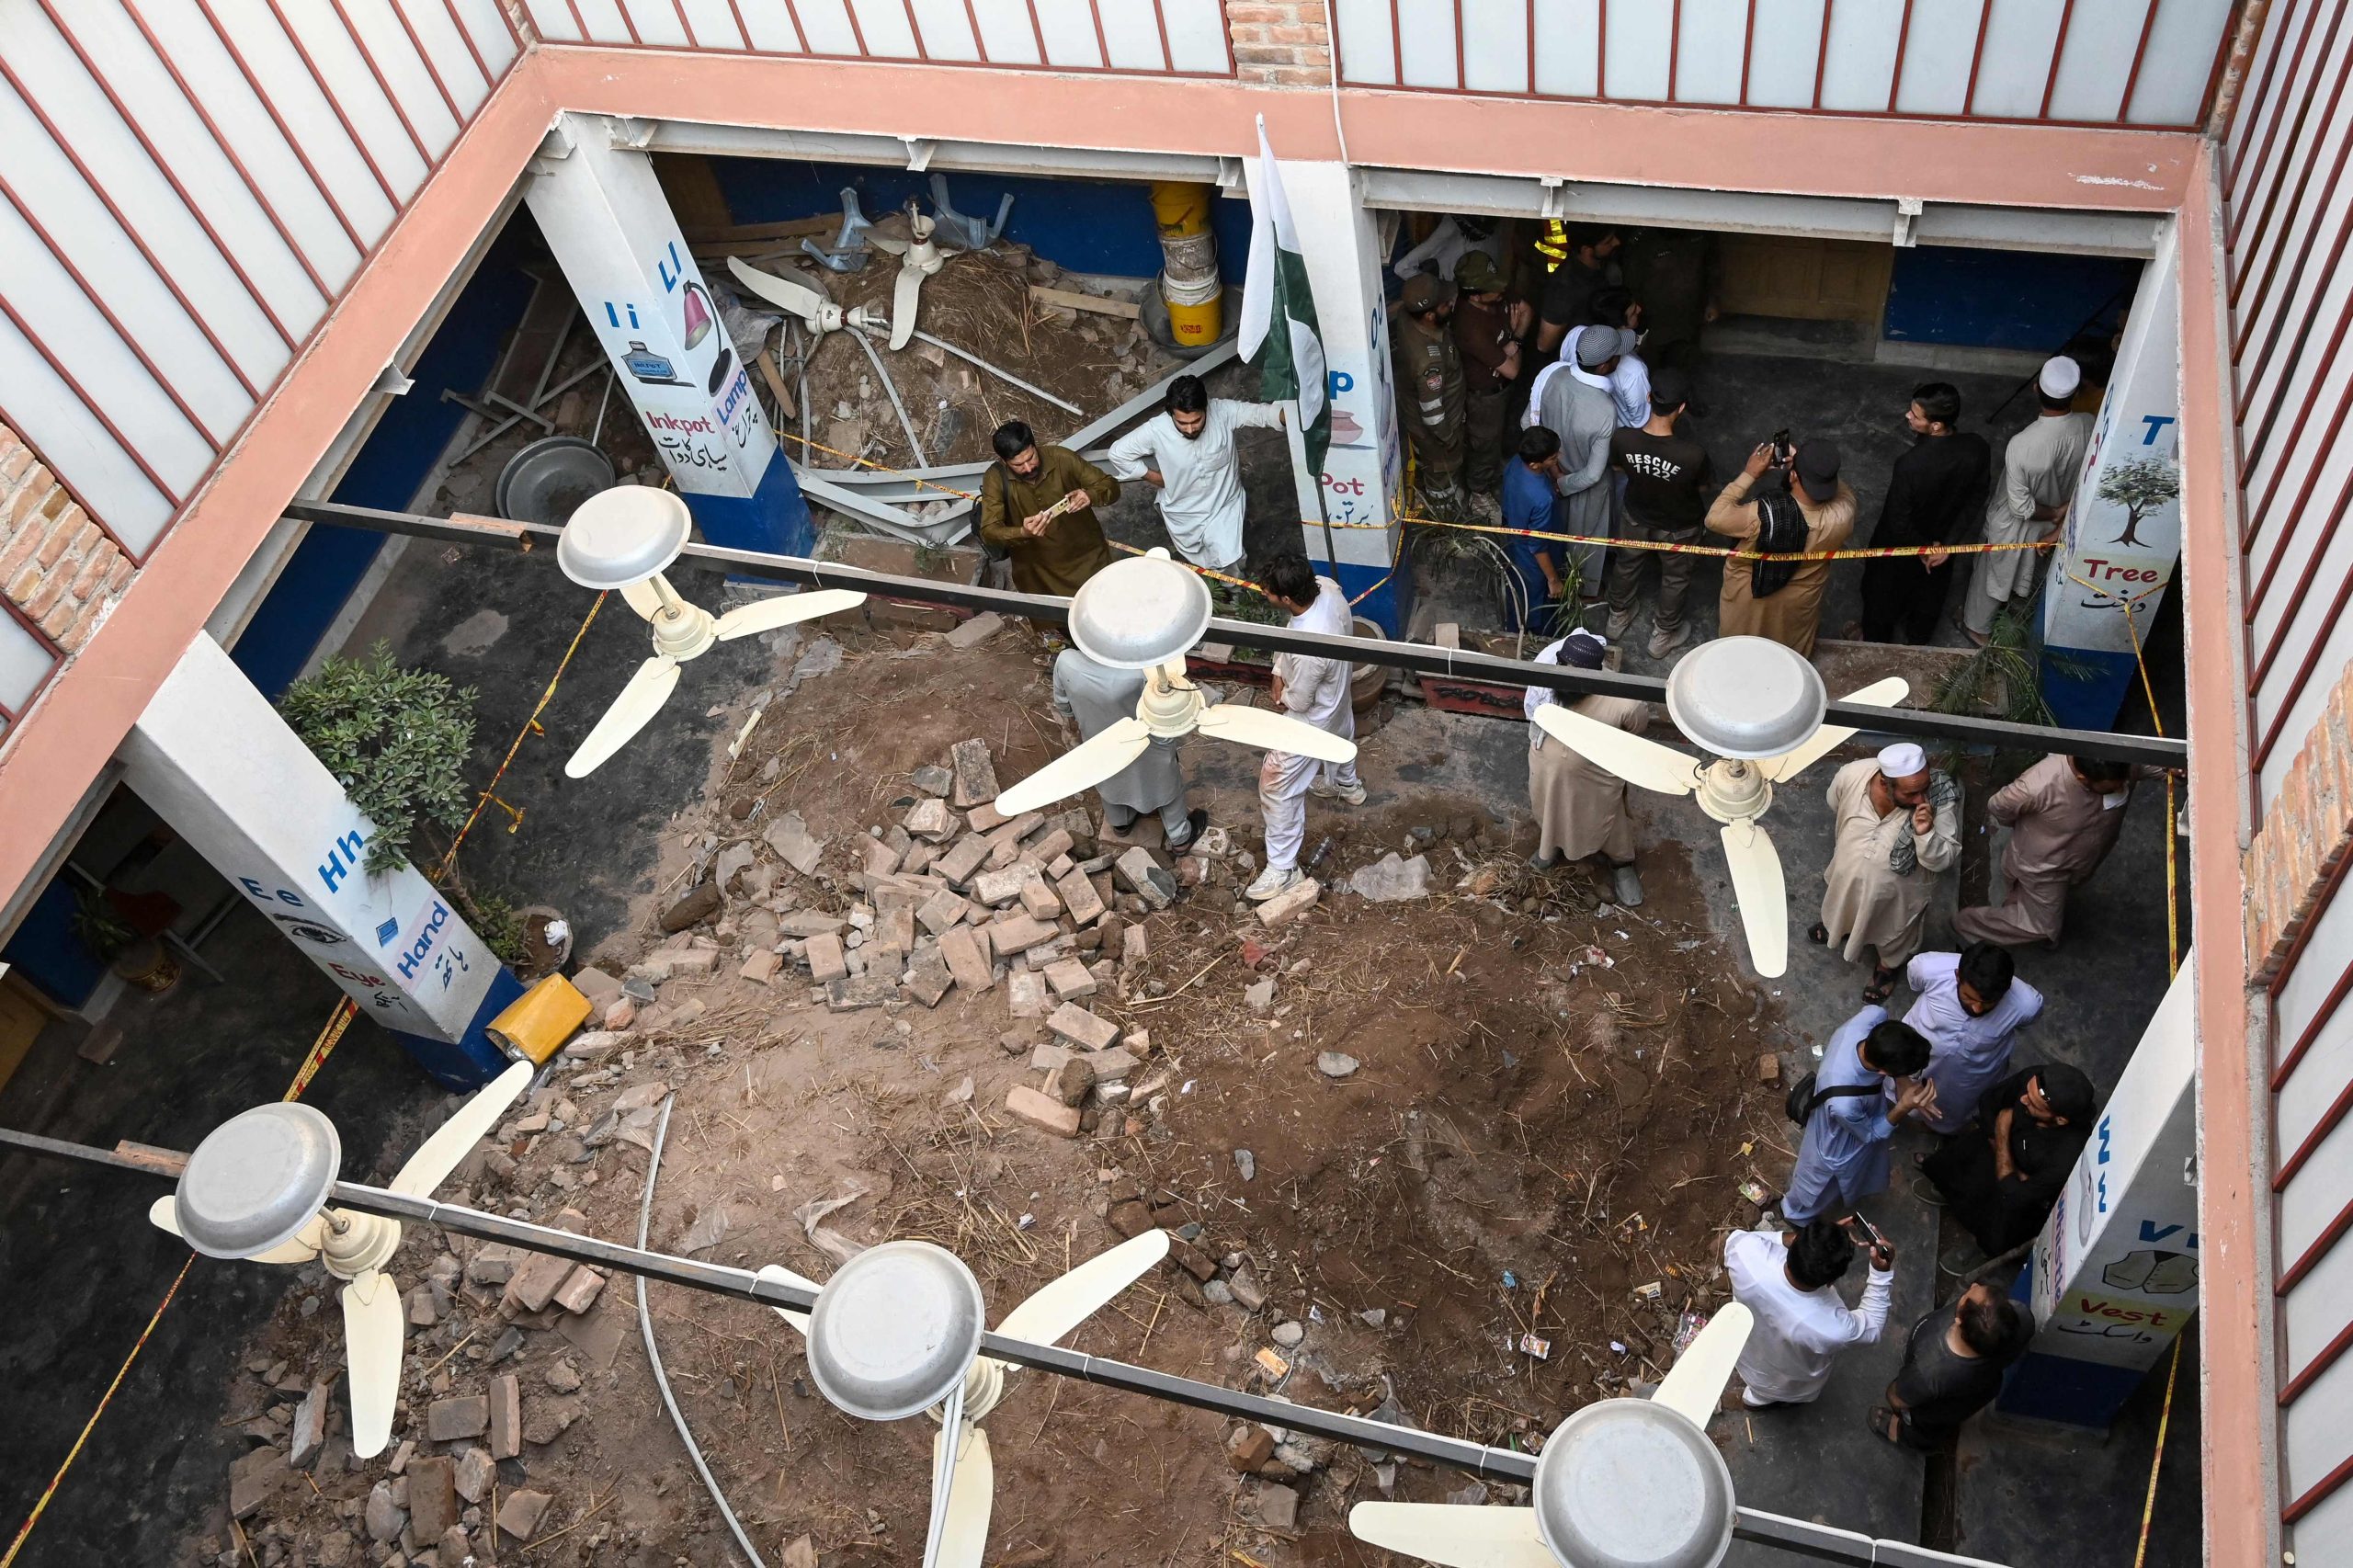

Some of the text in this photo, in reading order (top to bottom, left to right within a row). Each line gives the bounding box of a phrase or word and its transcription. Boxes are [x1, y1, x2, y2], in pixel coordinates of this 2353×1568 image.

[717, 369, 746, 426] Lamp
[645, 411, 715, 437] Inkpot
[1626, 453, 1681, 475] RESCUE
[1633, 464, 1670, 482] 1122
[2083, 559, 2158, 583] Tree
[397, 901, 449, 980] Hand
[327, 962, 386, 988] Eye
[2081, 1299, 2167, 1325] Vest
